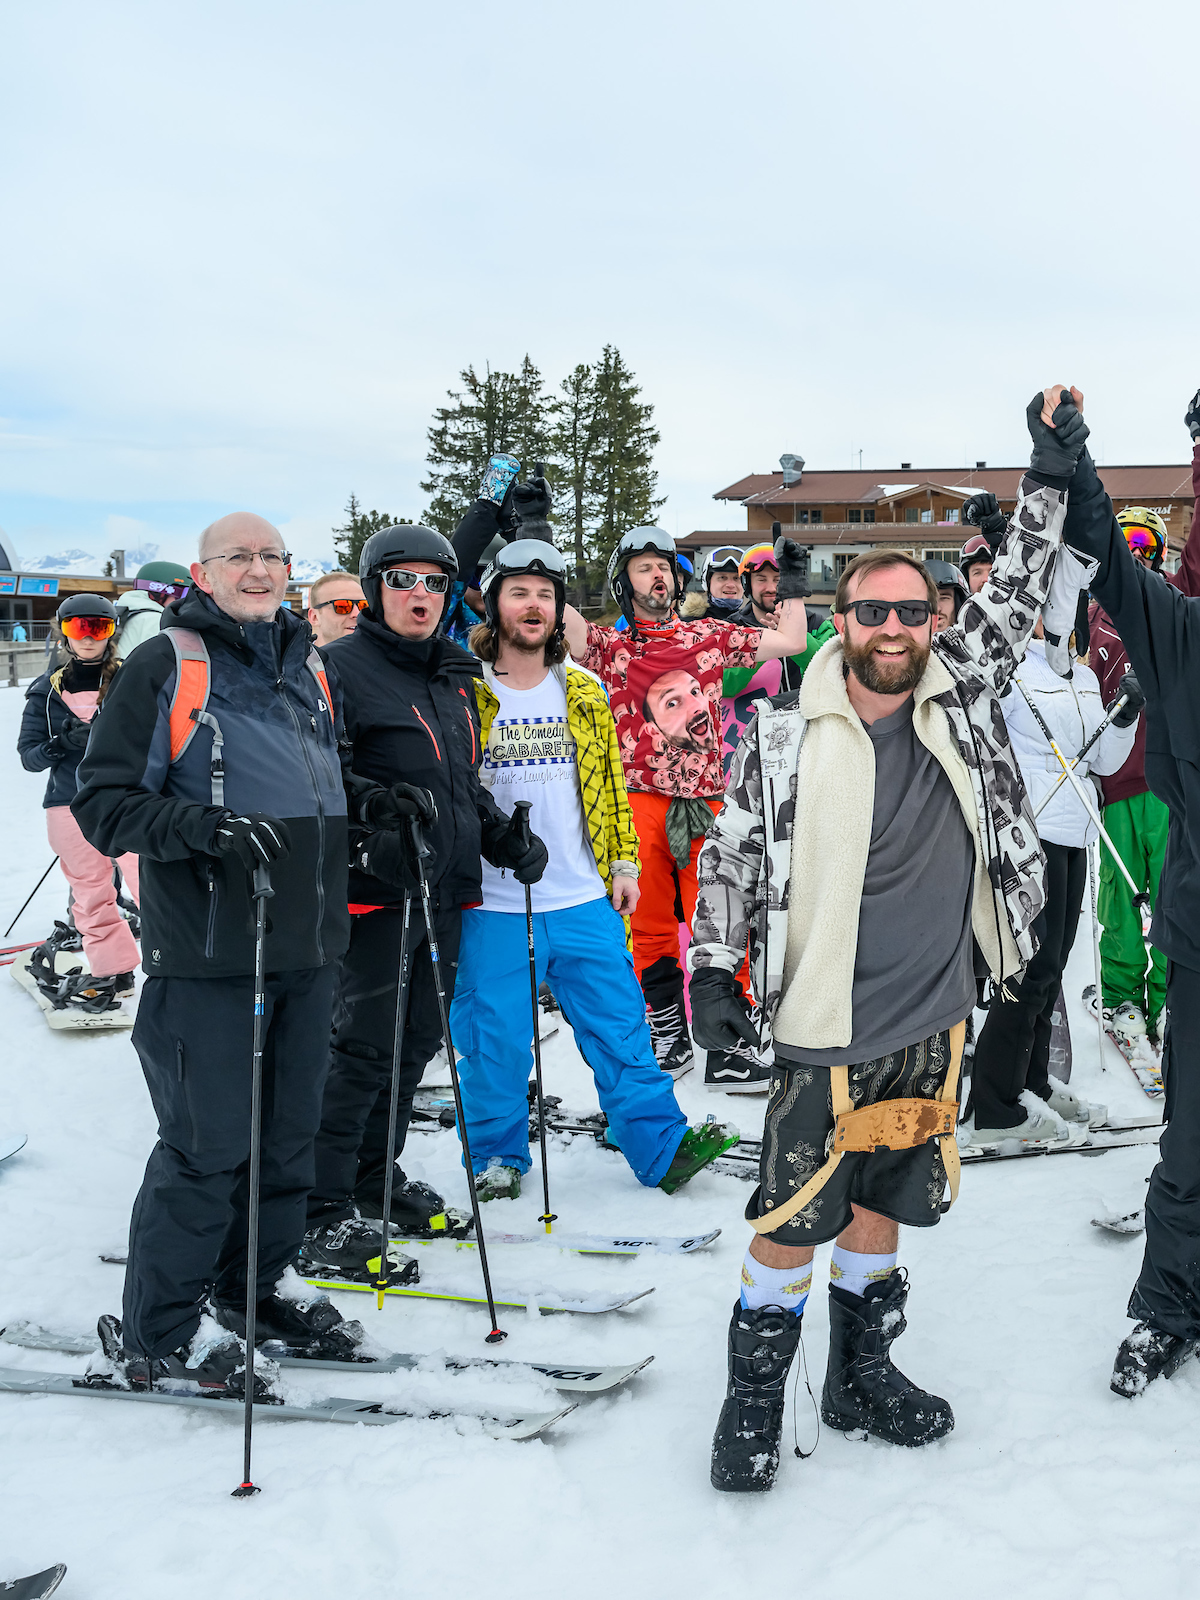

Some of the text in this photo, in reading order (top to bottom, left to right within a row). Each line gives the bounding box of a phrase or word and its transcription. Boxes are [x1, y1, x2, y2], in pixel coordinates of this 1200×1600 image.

[498, 723, 564, 742] The Comedy
[492, 741, 573, 760] CABARET
